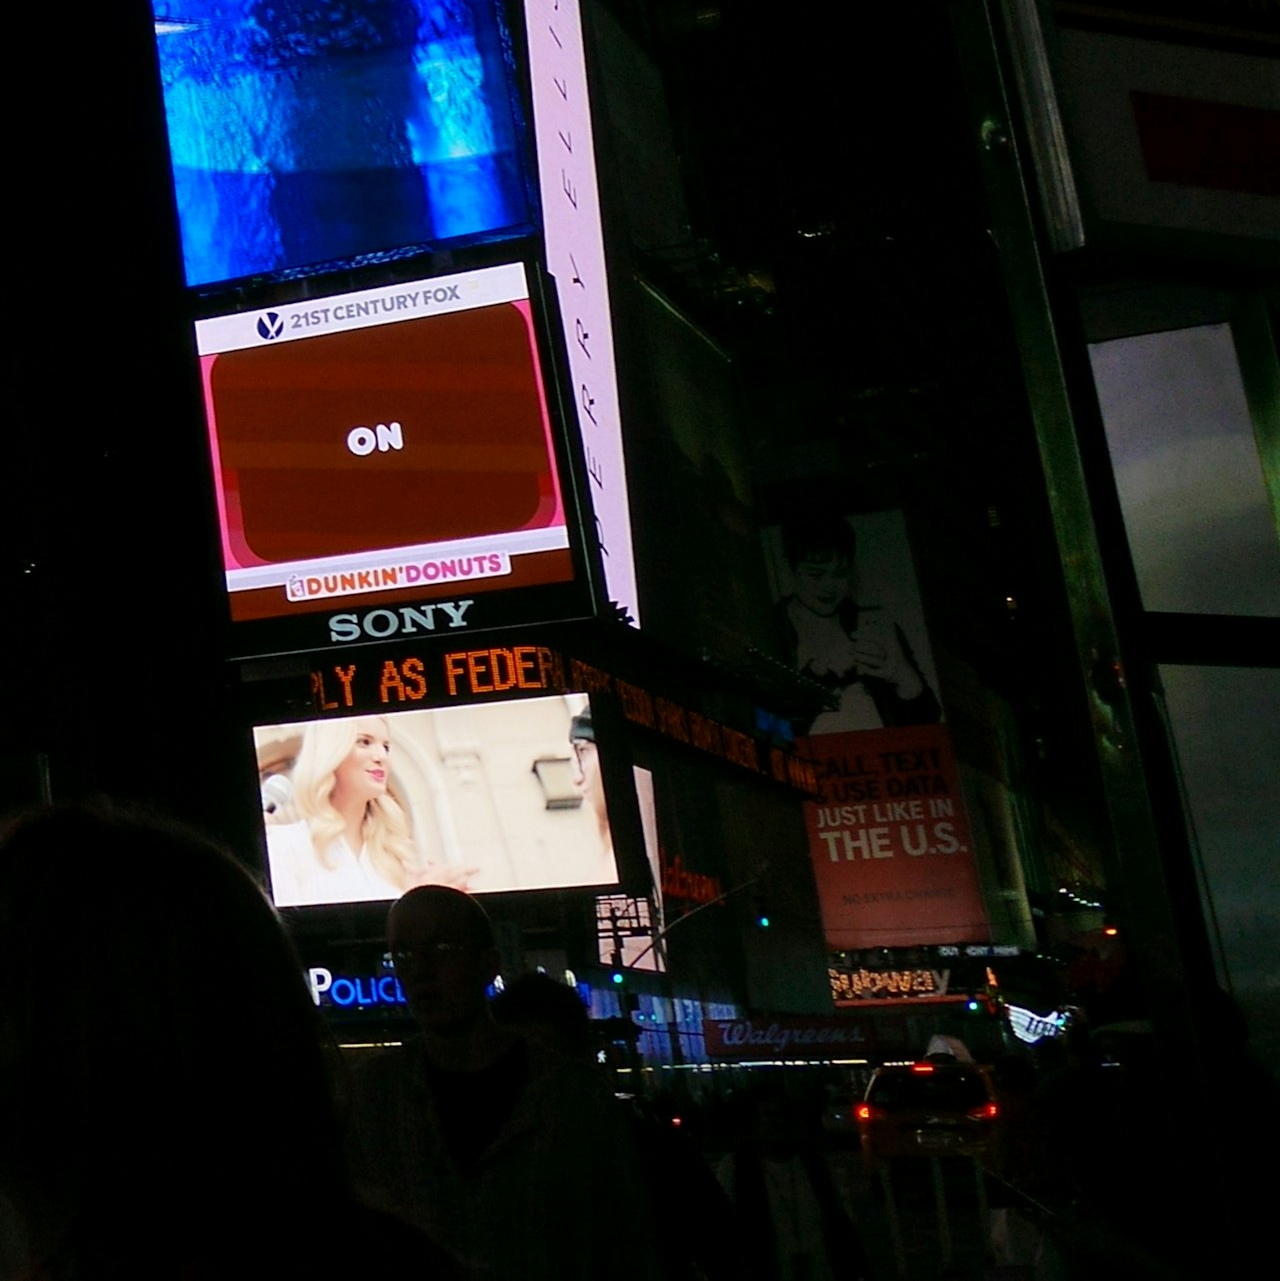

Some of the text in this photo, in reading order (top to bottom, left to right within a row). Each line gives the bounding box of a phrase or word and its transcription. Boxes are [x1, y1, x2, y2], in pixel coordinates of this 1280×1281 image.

[290, 285, 461, 329] 21ST CENTURY FOX
[347, 422, 403, 456] ON
[306, 554, 502, 596] DUNKIN' DONUTS
[328, 600, 474, 642] SONY
[380, 658, 427, 702] AS
[879, 749, 941, 771] TEXT
[833, 779, 881, 802] USE
[887, 773, 950, 797] DATA
[817, 797, 954, 829] JUST LIKE IN
[818, 821, 968, 863] THE U.S.
[718, 1020, 866, 1053] Walgreens
